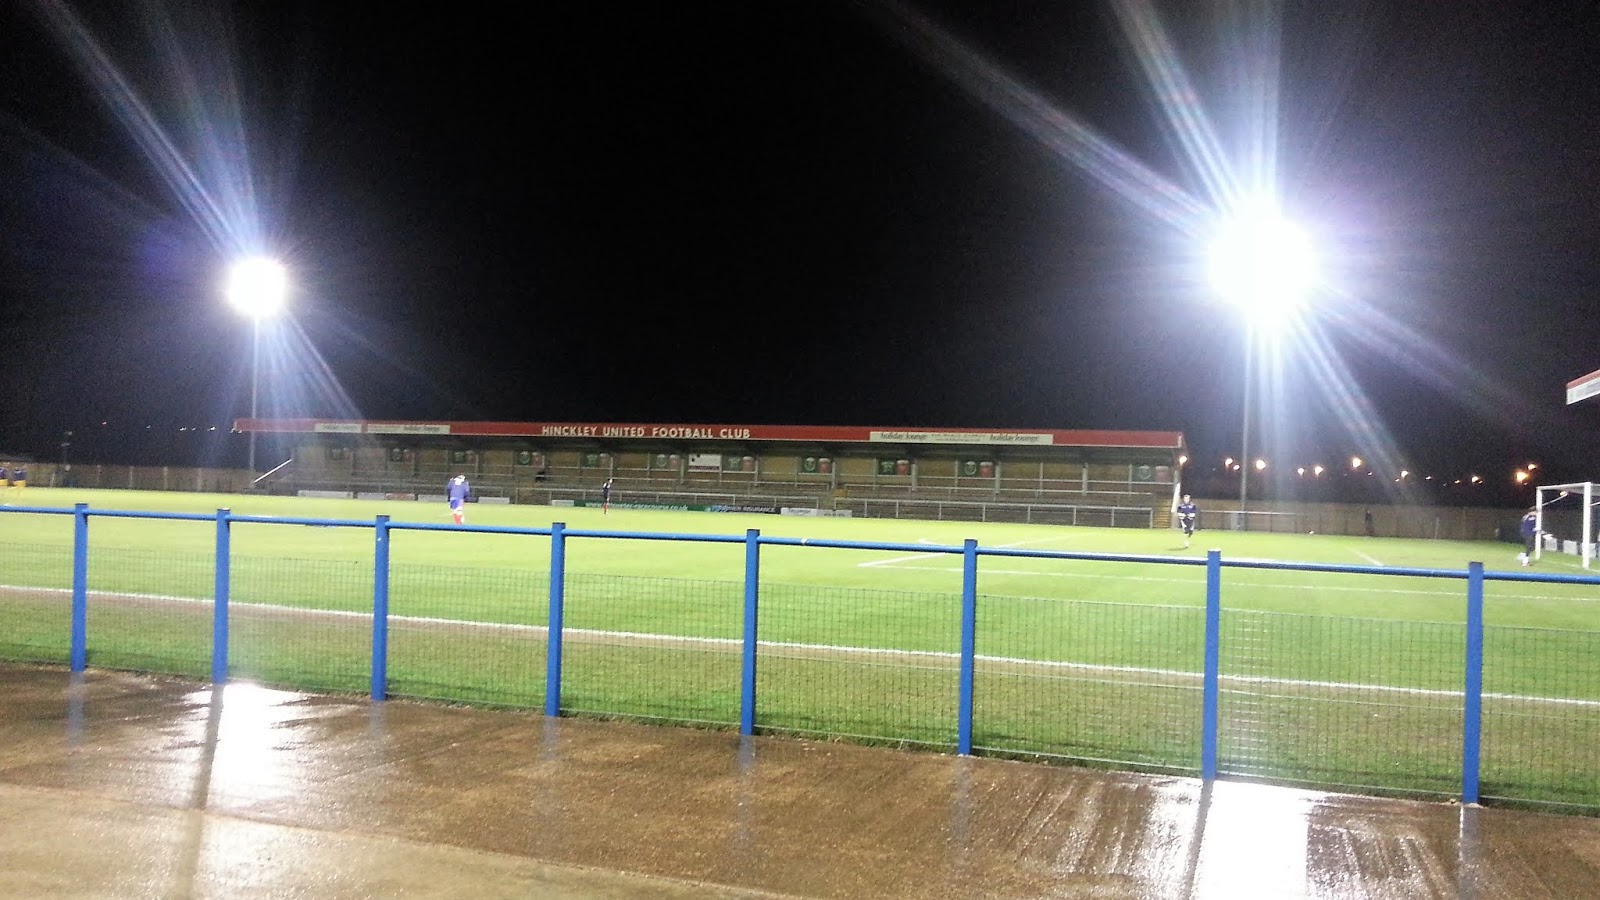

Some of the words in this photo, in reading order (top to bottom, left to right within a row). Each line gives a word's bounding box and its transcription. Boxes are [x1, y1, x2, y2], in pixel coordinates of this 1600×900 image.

[542, 425, 598, 436] HINCKLEY
[603, 426, 645, 437] UNITED
[652, 427, 713, 438] FOOTBALL
[720, 428, 750, 439] CLUB
